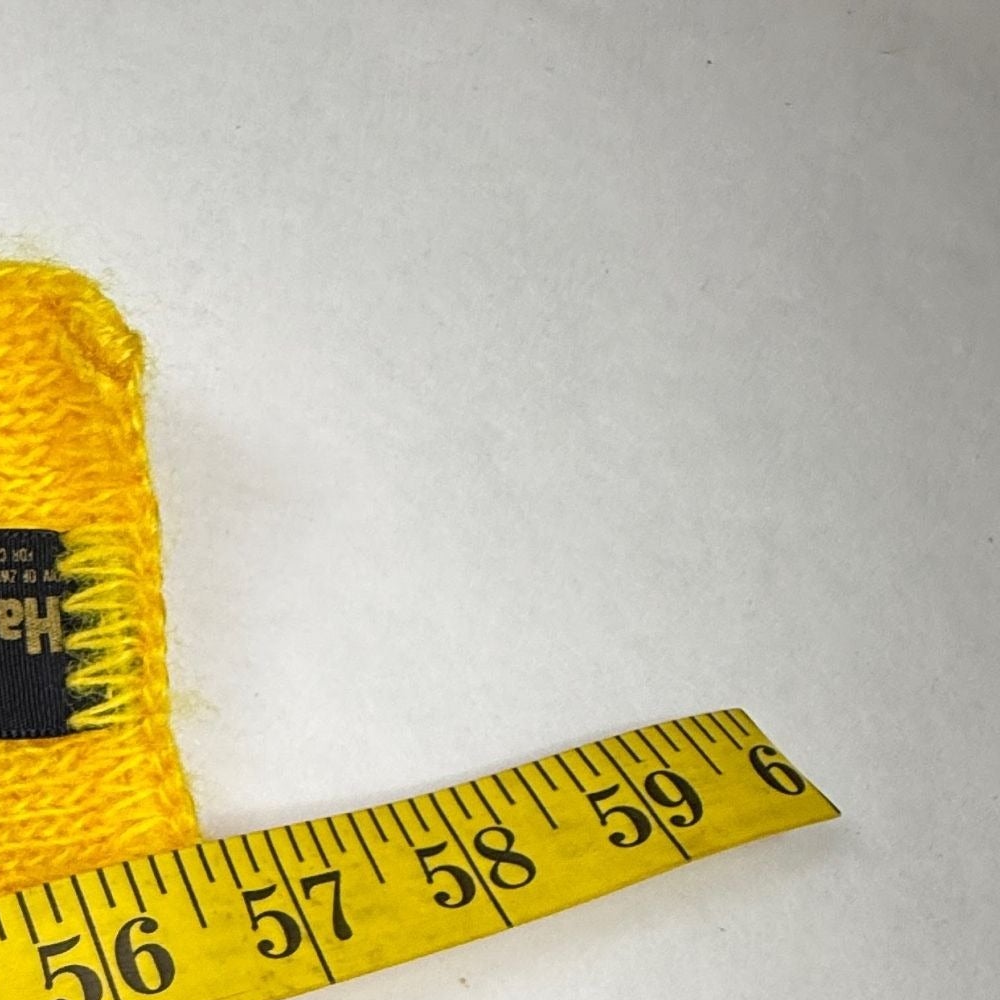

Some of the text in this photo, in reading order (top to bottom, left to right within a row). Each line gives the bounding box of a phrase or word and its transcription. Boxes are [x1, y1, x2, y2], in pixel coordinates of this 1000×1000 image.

[12, 547, 34, 563] FOR
[22, 569, 37, 584] OF
[241, 870, 354, 960] 57
[414, 826, 537, 908] 58
[585, 769, 704, 848] 59
